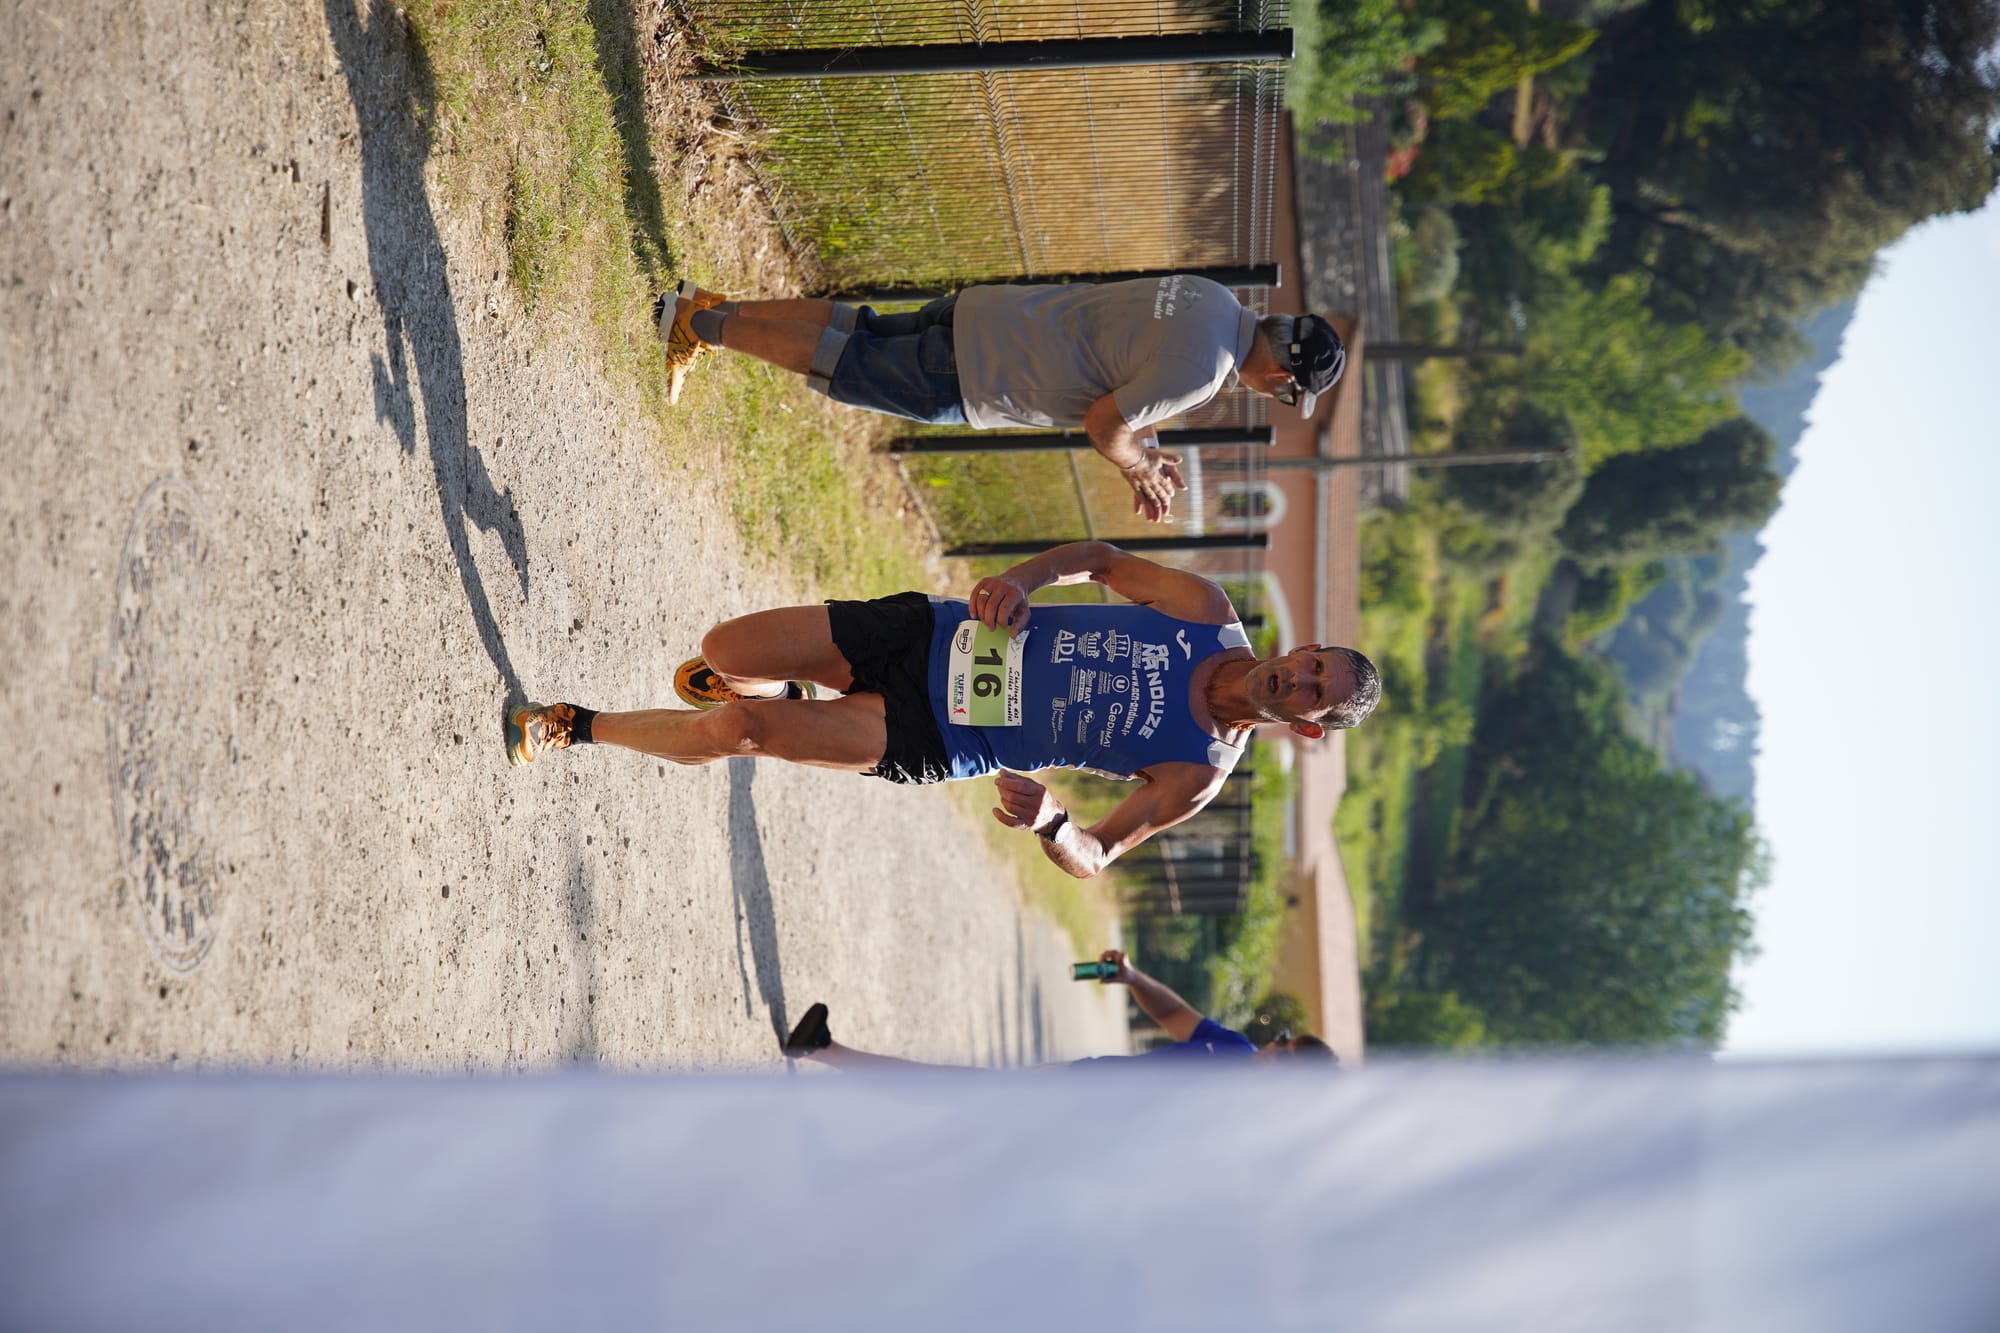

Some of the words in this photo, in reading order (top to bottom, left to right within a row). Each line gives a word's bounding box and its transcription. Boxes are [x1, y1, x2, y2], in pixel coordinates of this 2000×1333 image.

[1165, 303, 1176, 316] des
[1058, 630, 1076, 664] ADL
[973, 648, 1003, 698] 16
[1012, 671, 1020, 704] Challenge
[1121, 670, 1140, 736] www.acn-anduze.fr
